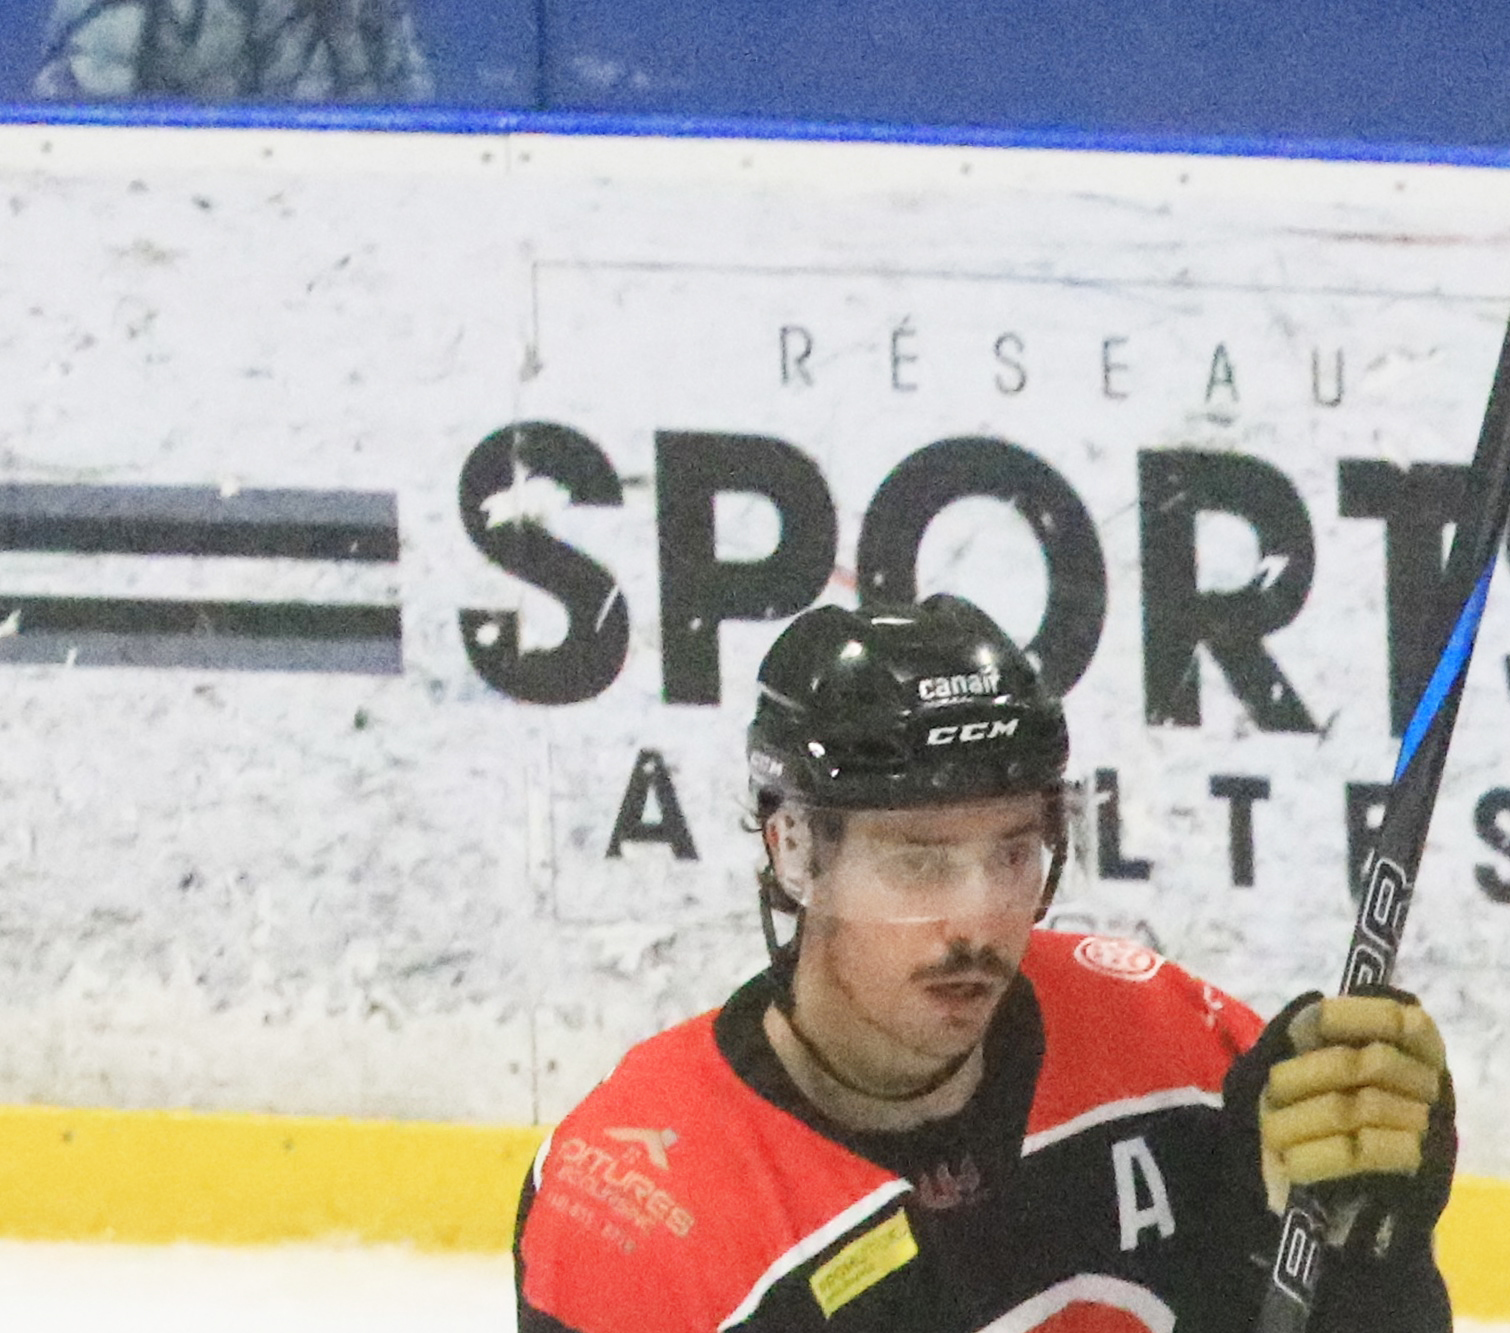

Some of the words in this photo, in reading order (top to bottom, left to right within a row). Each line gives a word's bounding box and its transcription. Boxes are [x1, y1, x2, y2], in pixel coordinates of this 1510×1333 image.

[778, 322, 1344, 406] RÉSEAU
[925, 718, 1020, 747] CCM
[1111, 1135, 1176, 1252] A
